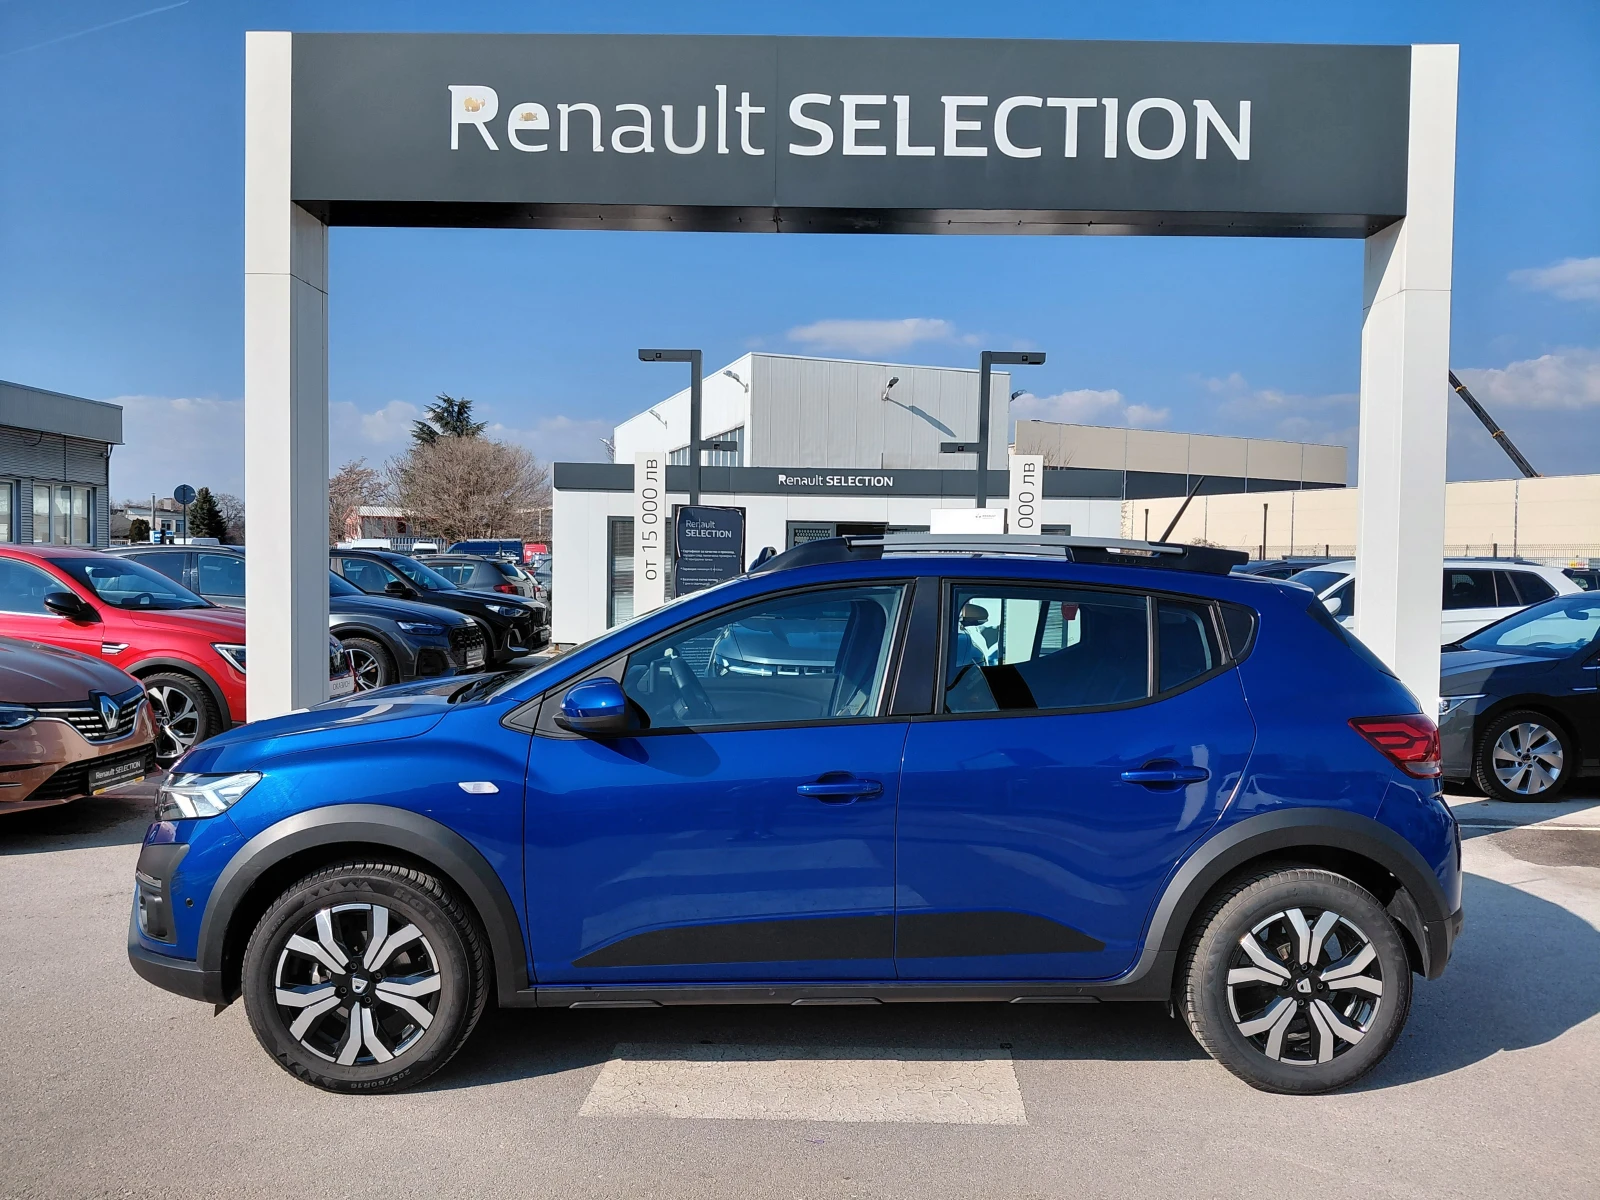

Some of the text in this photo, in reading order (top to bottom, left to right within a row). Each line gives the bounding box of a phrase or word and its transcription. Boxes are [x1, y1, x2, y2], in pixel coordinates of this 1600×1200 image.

[447, 84, 1252, 162] Renault SELECTION
[777, 474, 894, 487] Renault SELECTION
[1018, 463, 1035, 528] 000 лв
[641, 459, 658, 581] от 15 000 лв
[685, 519, 716, 529] Renault
[685, 529, 732, 538] SELECTION
[95, 768, 115, 780] Renault
[115, 760, 141, 775] SELECTION
